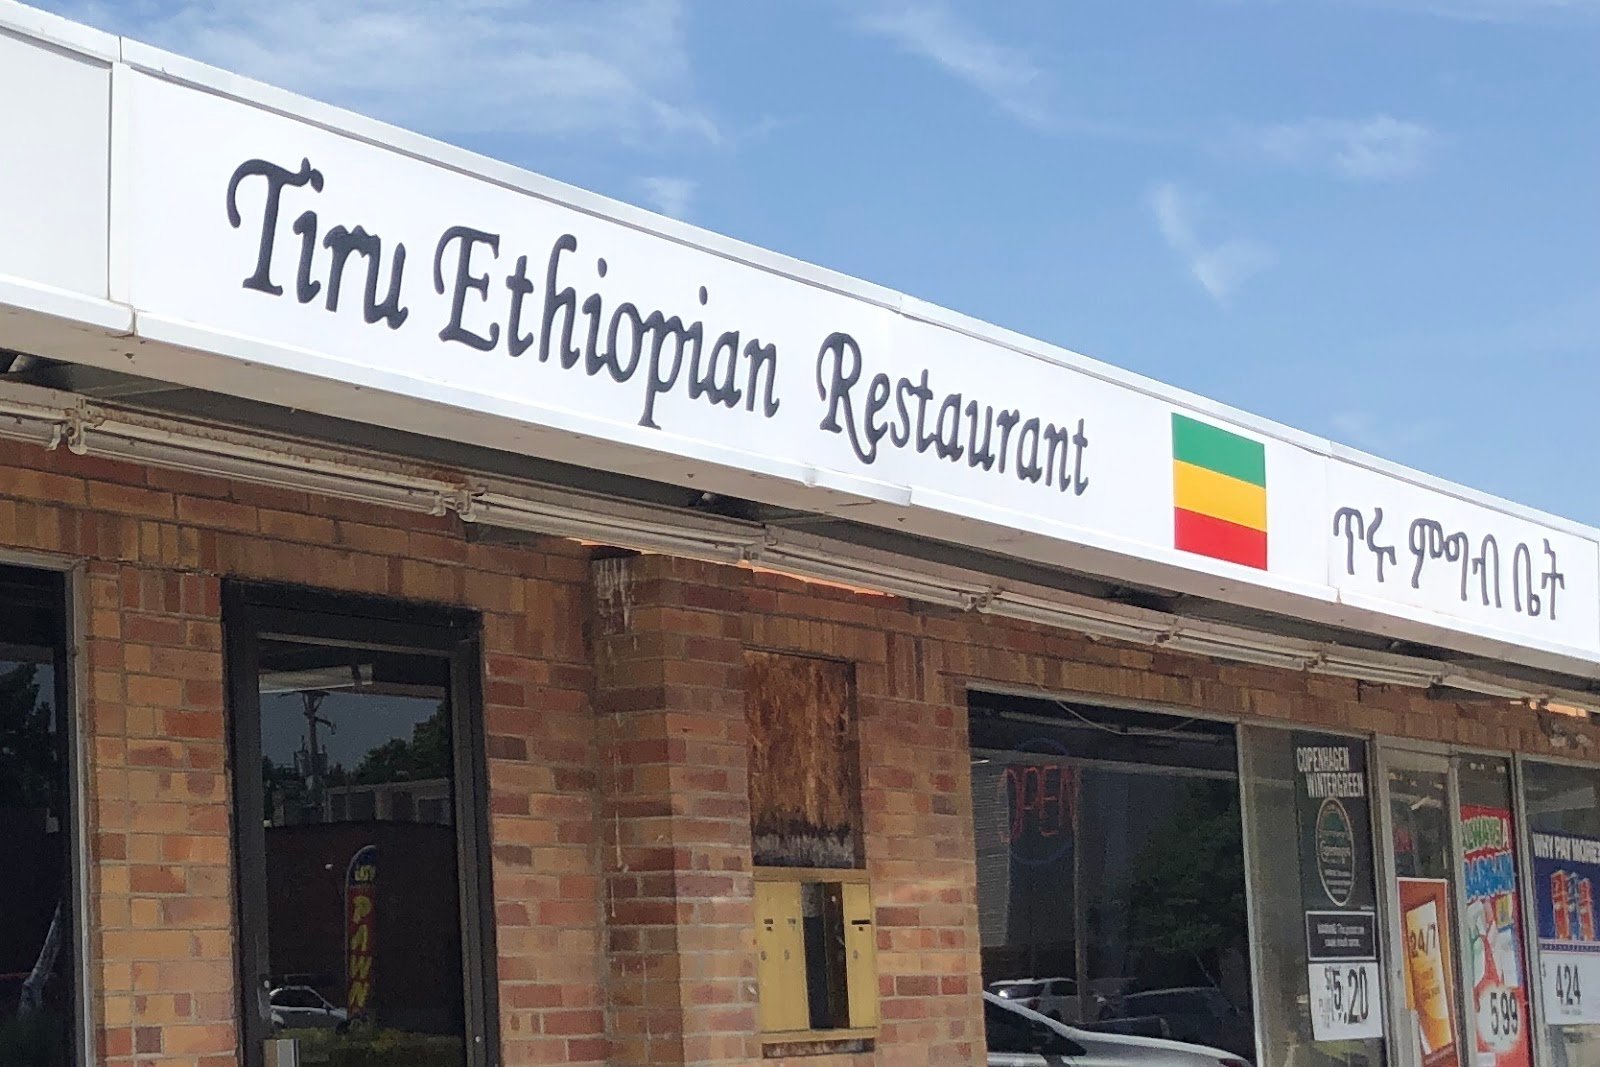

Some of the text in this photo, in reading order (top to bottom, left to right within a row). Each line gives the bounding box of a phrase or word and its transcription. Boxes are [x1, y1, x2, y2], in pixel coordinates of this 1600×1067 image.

[226, 157, 1090, 496] Tiru Ethiopian Restaurant
[1513, 538, 1565, 620] ቤት
[1297, 747, 1349, 772] COPENHAGEN
[1306, 772, 1364, 798] WINTERGREEN
[1533, 833, 1554, 859] WHY
[1554, 835, 1571, 861] PAY
